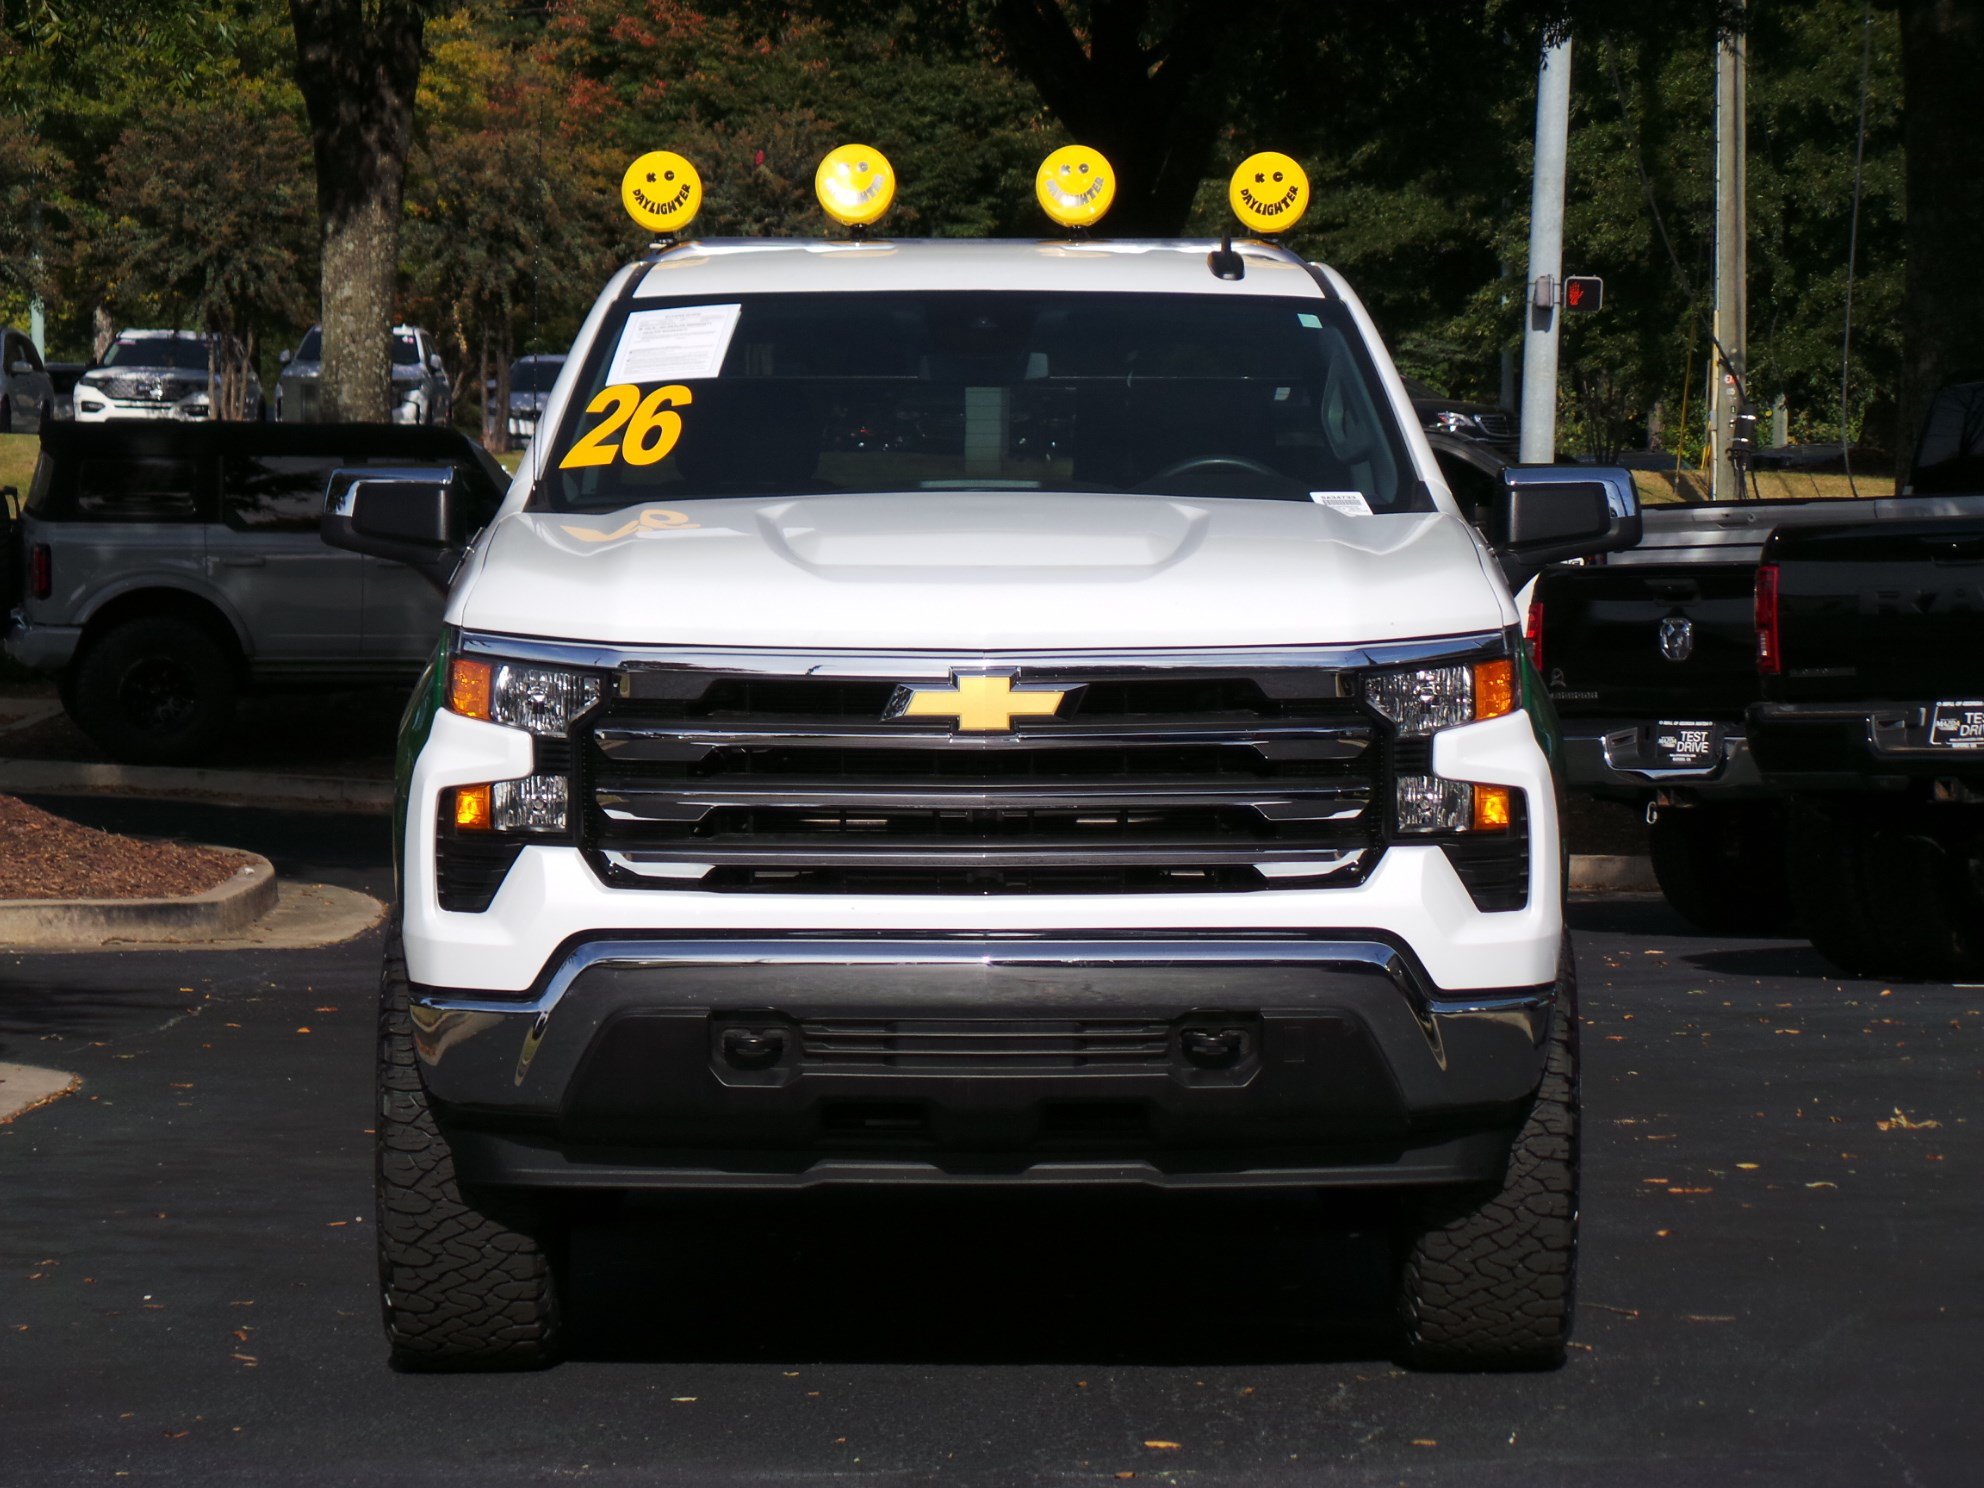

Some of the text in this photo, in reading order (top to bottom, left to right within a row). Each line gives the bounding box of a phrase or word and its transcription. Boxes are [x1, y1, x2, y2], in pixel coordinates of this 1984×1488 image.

[632, 183, 691, 215] DAYLIGHTER
[1240, 185, 1299, 216] DAYLIGHTER
[558, 383, 693, 469] 26
[1964, 712, 1984, 724] TE
[1680, 731, 1709, 743] TEST
[1959, 725, 1984, 737] DRI
[1676, 741, 1710, 753] DRIVE
